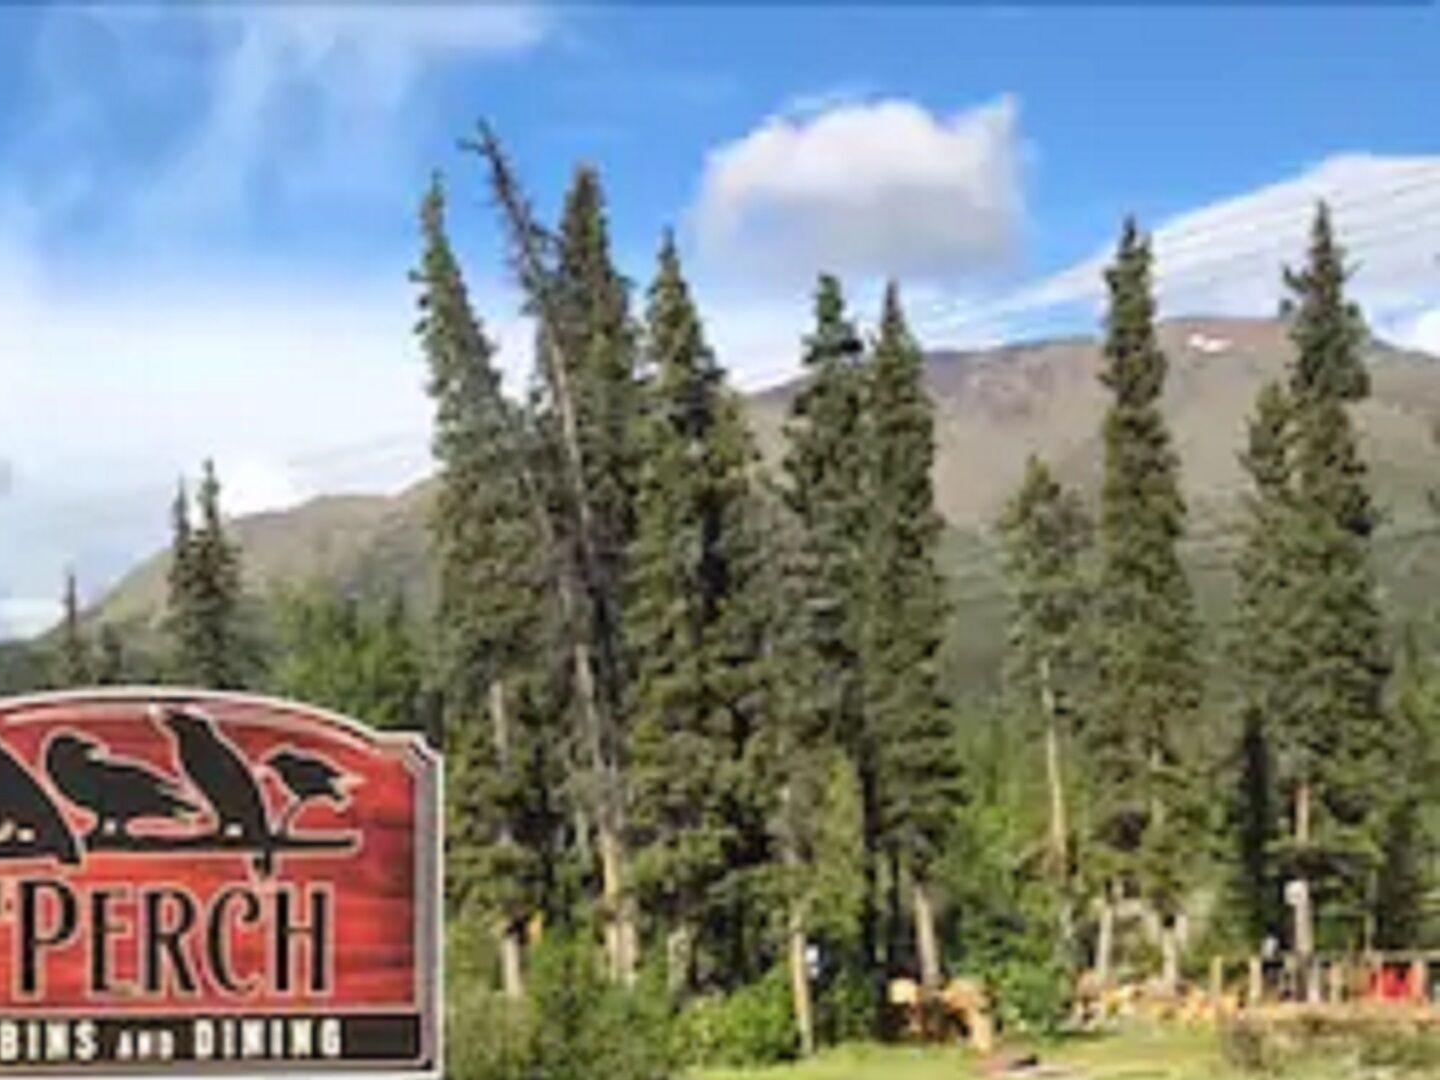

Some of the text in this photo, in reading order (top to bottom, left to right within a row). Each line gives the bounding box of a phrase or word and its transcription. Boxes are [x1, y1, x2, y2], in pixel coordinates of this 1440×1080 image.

[15, 877, 334, 999] PERCH
[116, 1029, 175, 1060] AND
[194, 1018, 344, 1060] DINING
